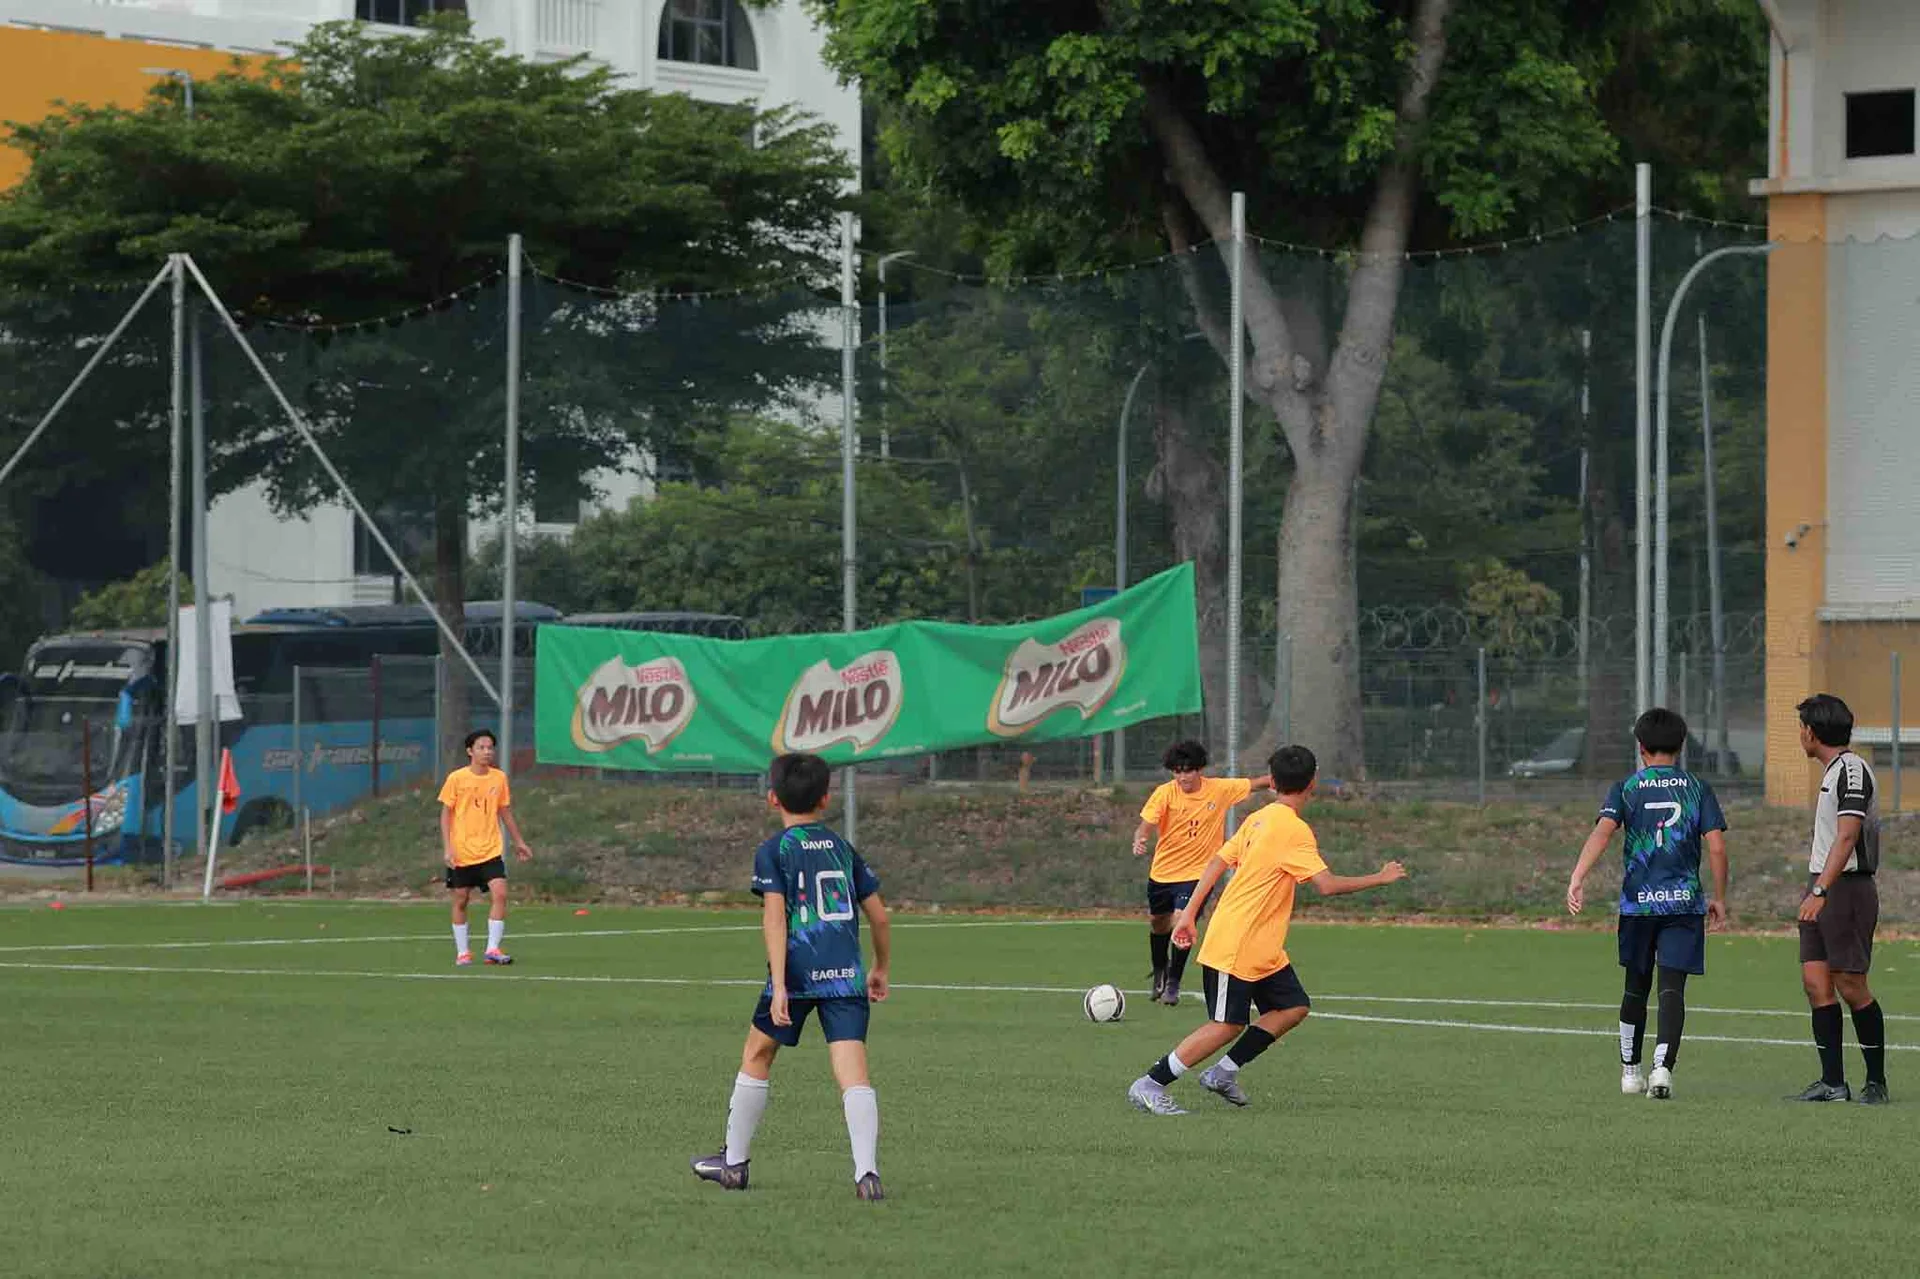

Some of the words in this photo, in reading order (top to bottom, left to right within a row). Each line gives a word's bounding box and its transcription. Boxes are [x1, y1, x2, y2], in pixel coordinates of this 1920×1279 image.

[1006, 643, 1111, 712] MILO
[588, 684, 684, 727] MILO
[793, 680, 890, 737] MILO
[1639, 778, 1688, 788] MAISON
[800, 840, 834, 850] DAVID
[1644, 801, 1681, 848] 7
[798, 870, 854, 922] 10
[1637, 890, 1691, 903] EAGLES
[811, 968, 856, 981] EAGLES
